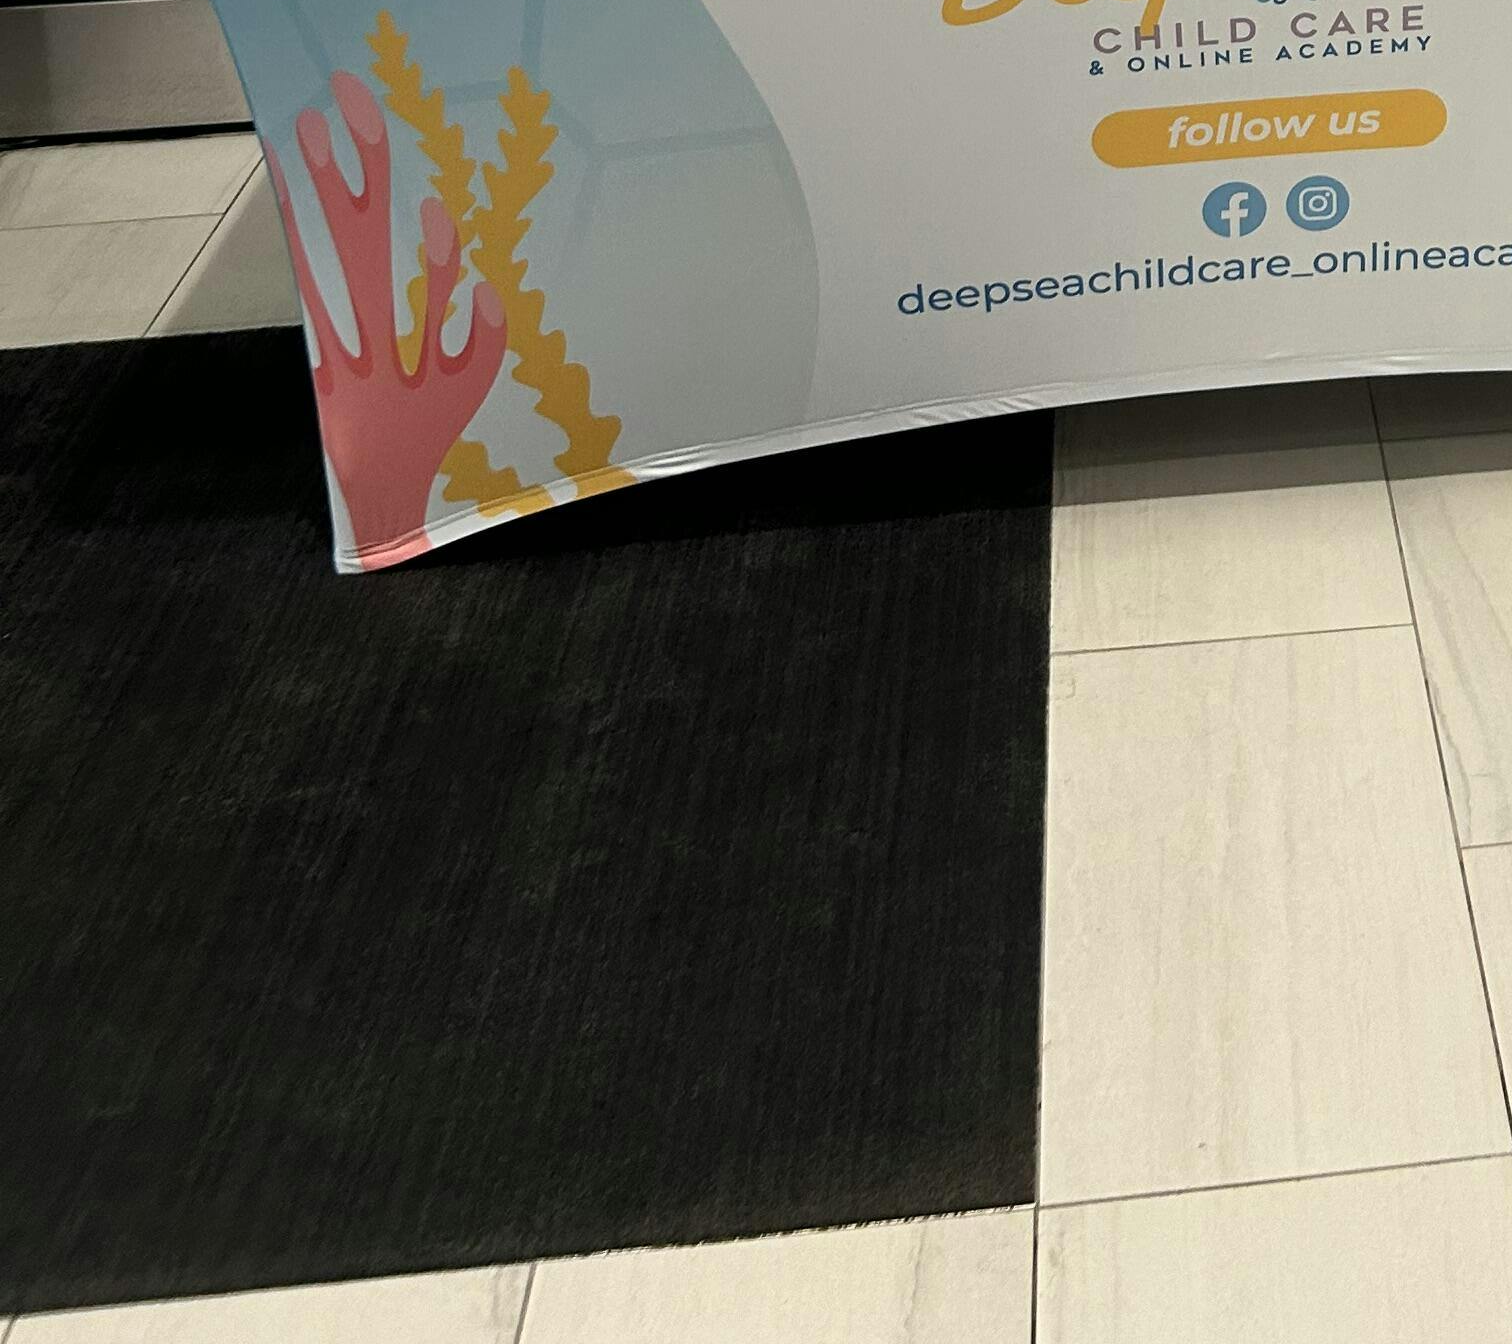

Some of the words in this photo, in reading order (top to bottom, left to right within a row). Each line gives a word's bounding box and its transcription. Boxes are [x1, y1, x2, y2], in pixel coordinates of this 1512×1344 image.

[1094, 18, 1258, 54] CHILD
[1290, 4, 1426, 38] CARE
[1088, 60, 1104, 76] &
[1127, 48, 1254, 73] ONLINE
[1275, 36, 1434, 61] ACADEMY
[1166, 111, 1314, 150] follow
[1327, 107, 1381, 138] us
